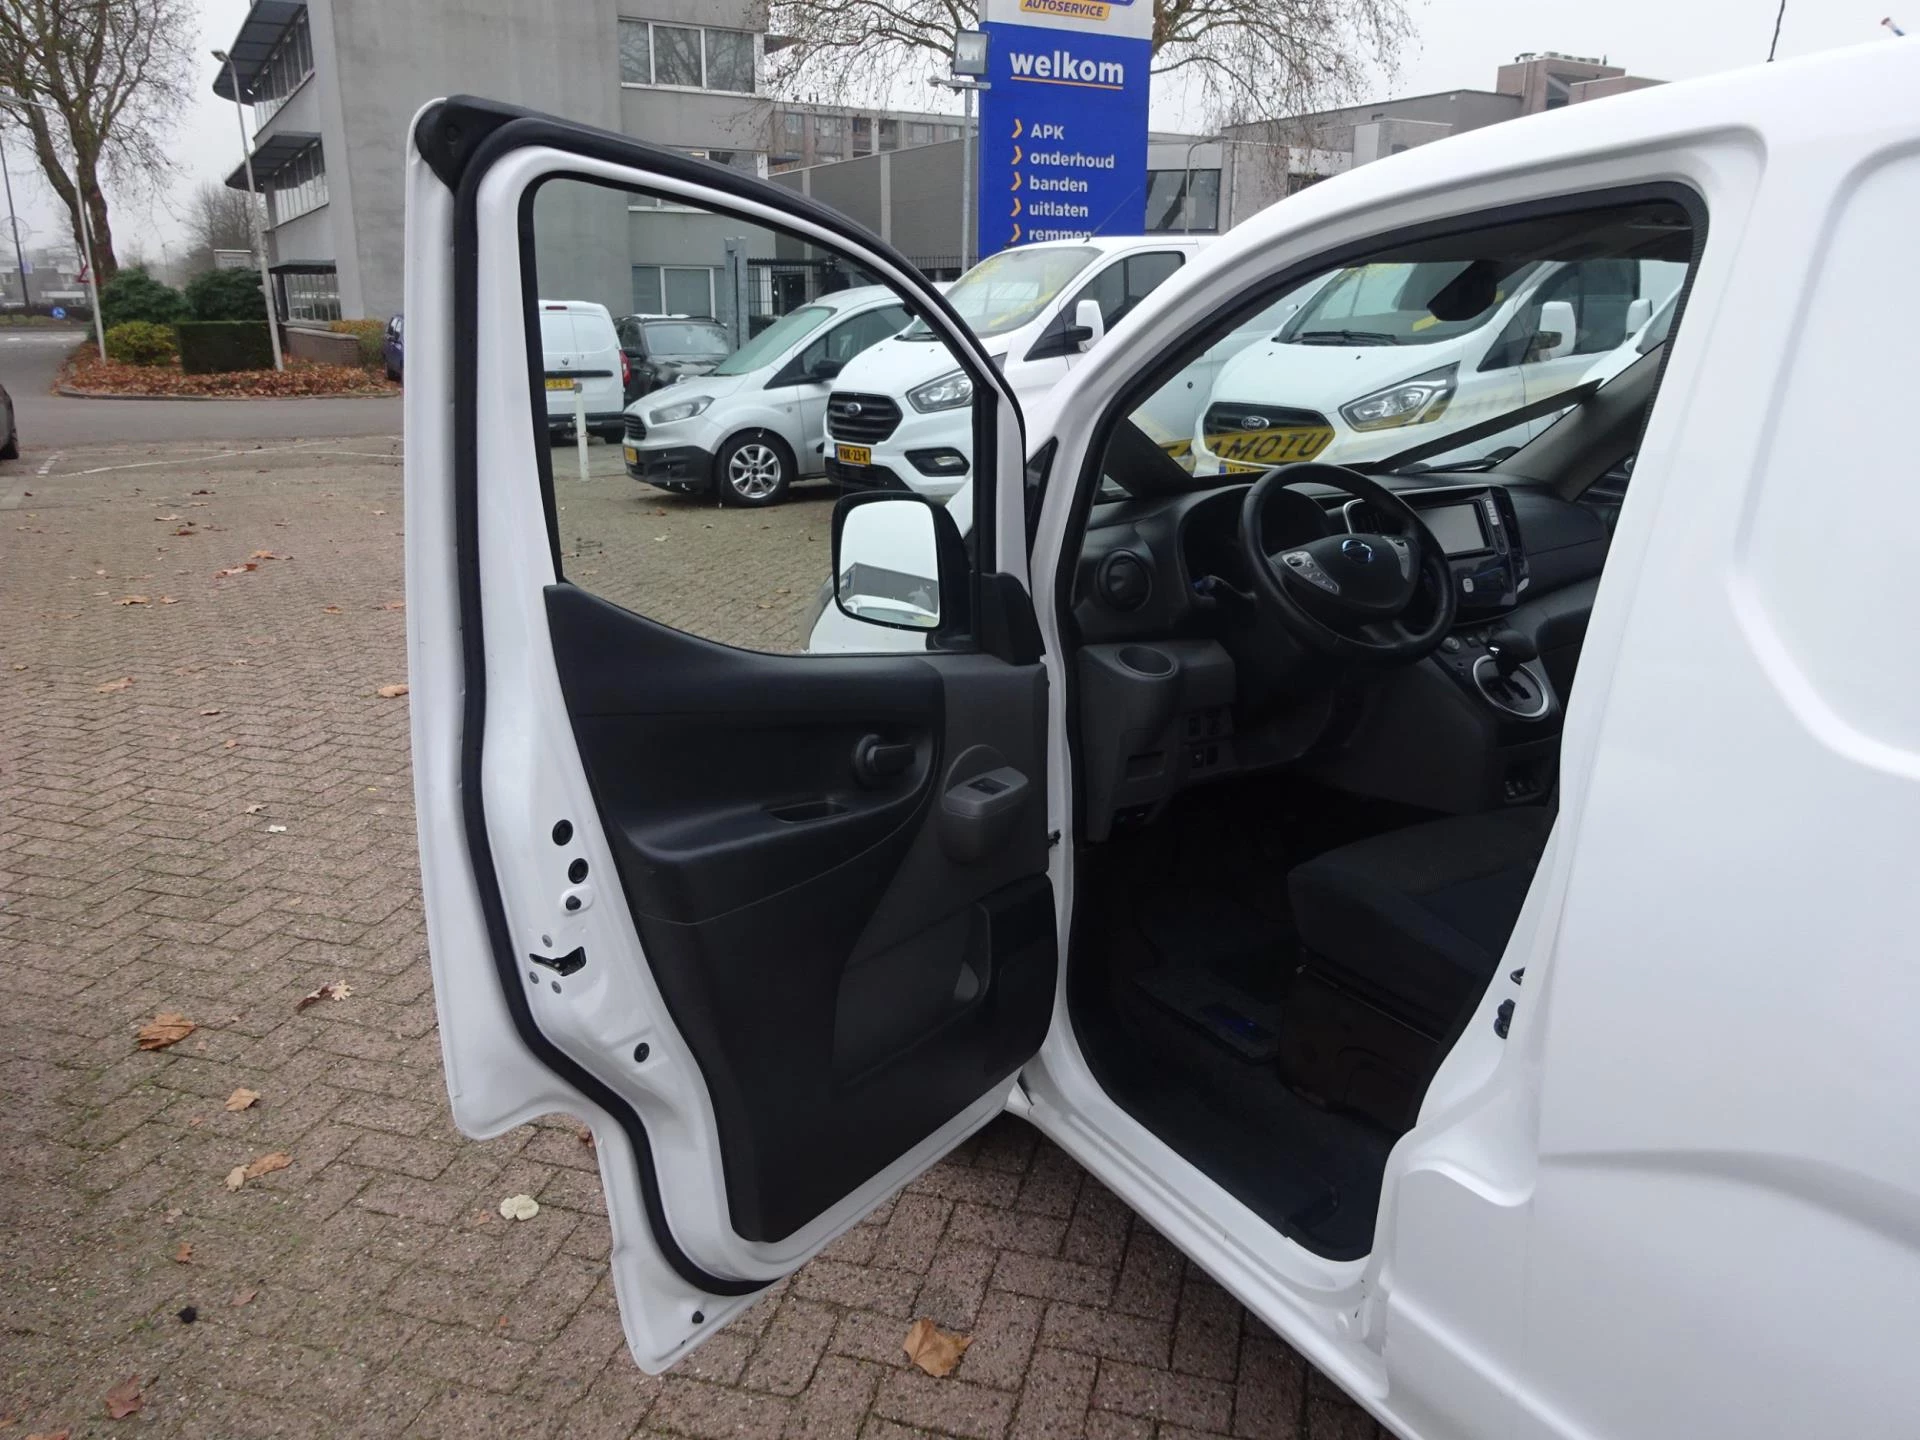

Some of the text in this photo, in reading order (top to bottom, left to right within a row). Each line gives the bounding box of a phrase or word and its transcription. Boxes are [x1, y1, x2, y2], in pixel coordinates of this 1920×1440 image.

[1025, 0, 1104, 17] AUTOSERVICE
[1009, 51, 1124, 84] welkom
[1030, 123, 1065, 140] APK
[1029, 151, 1115, 169] onderhoud
[1029, 176, 1088, 192] banden
[1029, 201, 1089, 217] uitlaten
